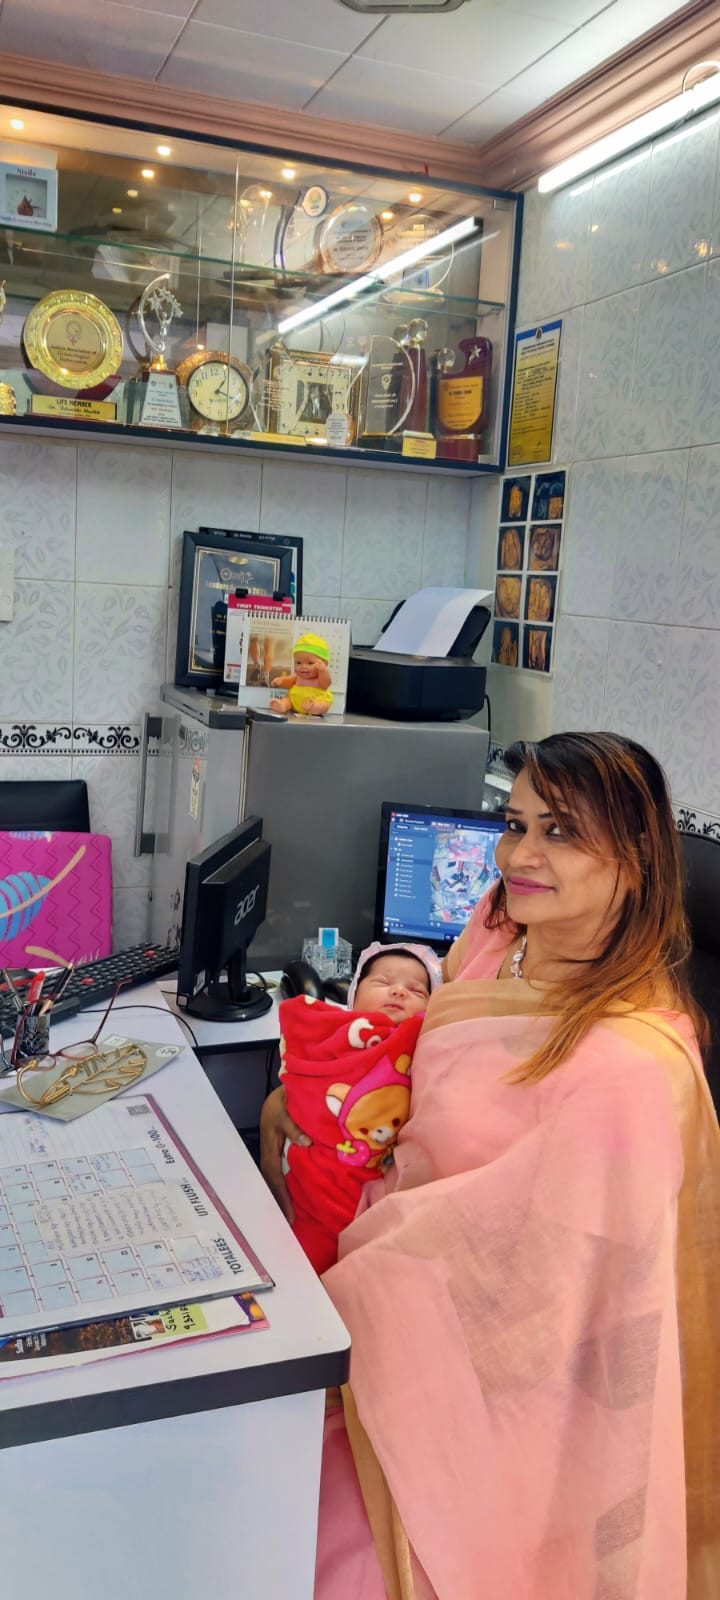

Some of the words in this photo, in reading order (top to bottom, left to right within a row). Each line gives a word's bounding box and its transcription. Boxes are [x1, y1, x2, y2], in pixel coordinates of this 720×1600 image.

[69, 400, 92, 408] MEMBER
[233, 884, 260, 926] acer
[213, 1237, 245, 1275] TOTALEES
